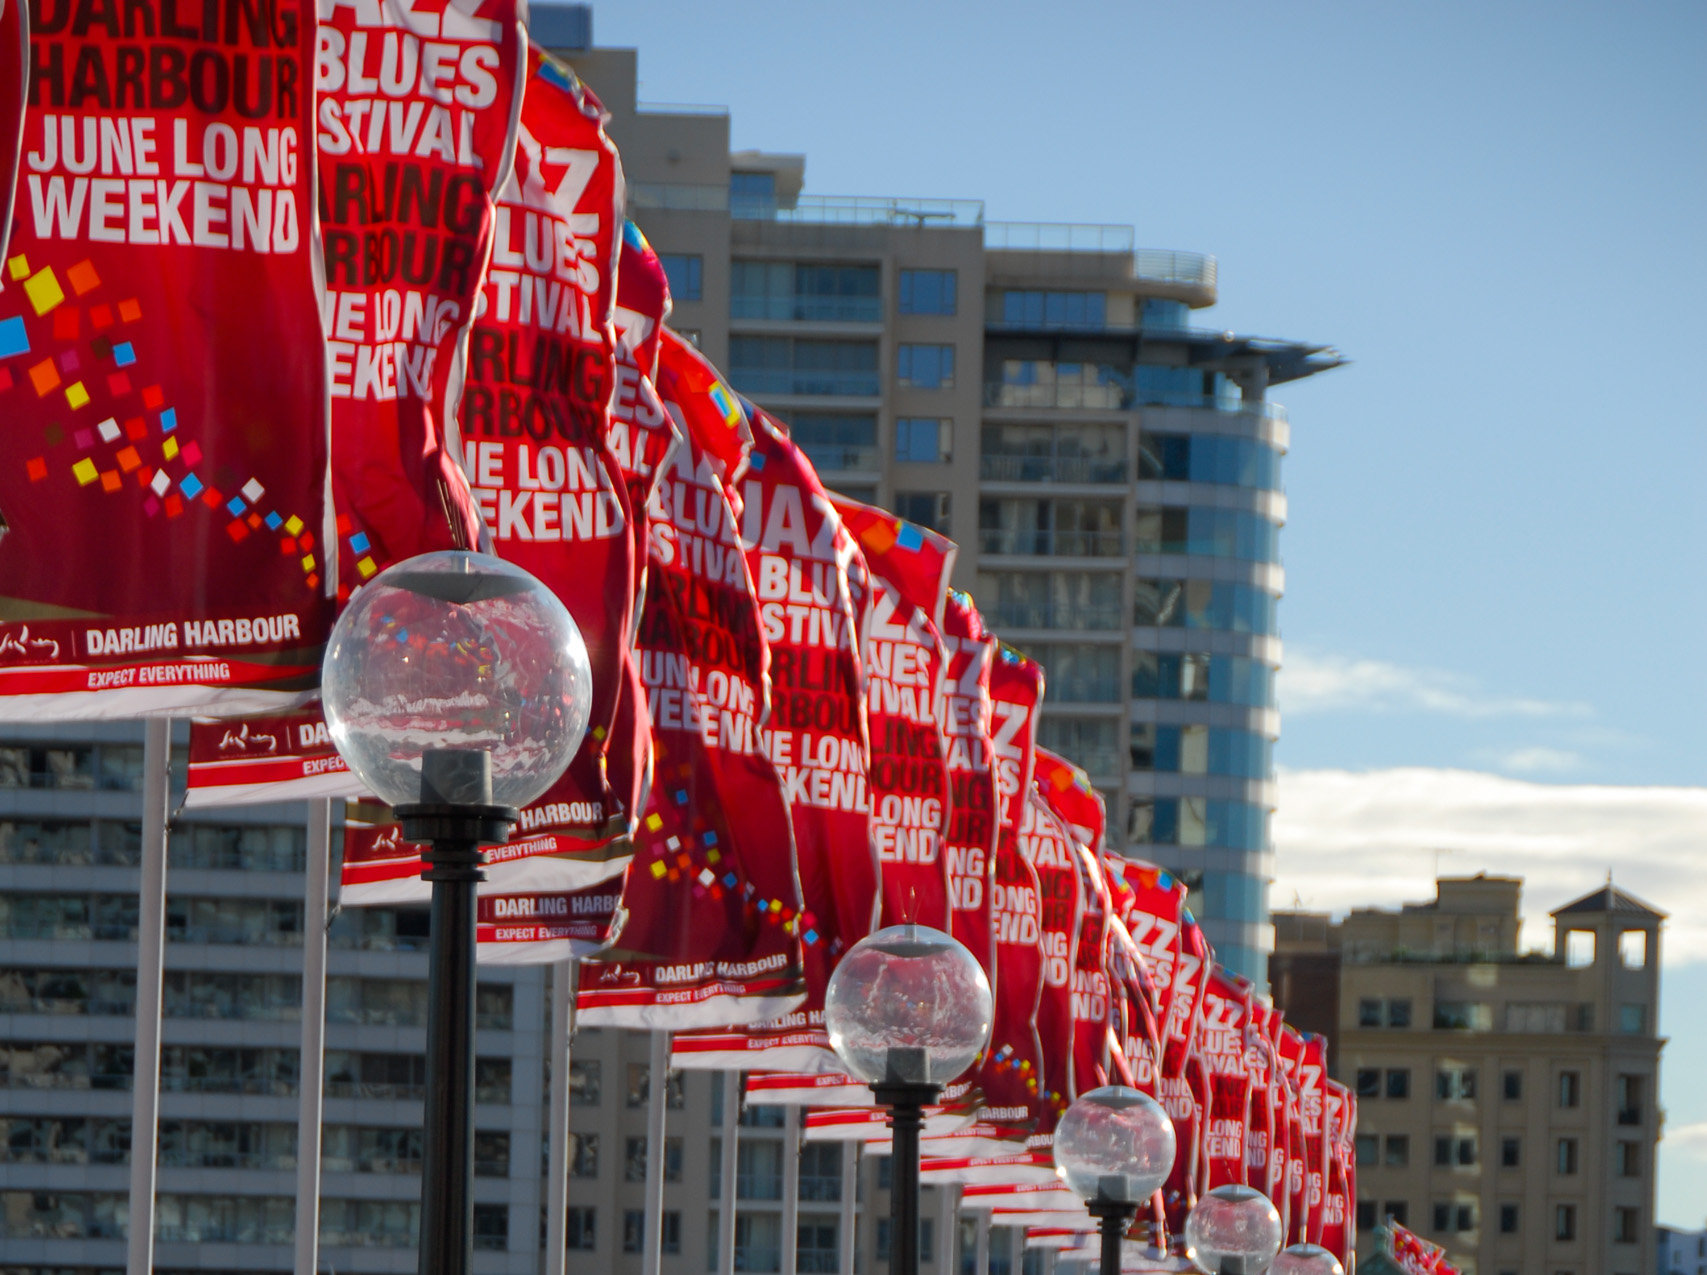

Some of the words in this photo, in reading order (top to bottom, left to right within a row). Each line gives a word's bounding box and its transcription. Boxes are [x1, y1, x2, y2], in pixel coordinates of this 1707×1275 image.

[28, 0, 298, 48] DARLING
[27, 42, 298, 119] HARBOUR
[317, 25, 500, 109] BLUES
[27, 114, 160, 176] JUNE
[172, 117, 298, 186] LONG
[27, 174, 300, 254] WEEKEND
[86, 621, 178, 656] DARLING
[183, 613, 301, 646] HARBOUR
[87, 668, 136, 688] EXPECT
[138, 662, 231, 683] EVERYTHING
[520, 802, 603, 833] HARBOUR
[495, 898, 567, 919] DARLING
[496, 925, 536, 943] EXPECT
[538, 924, 598, 943] EVERYTHING
[655, 961, 714, 983] DARLING
[717, 953, 788, 978] HARBOUR
